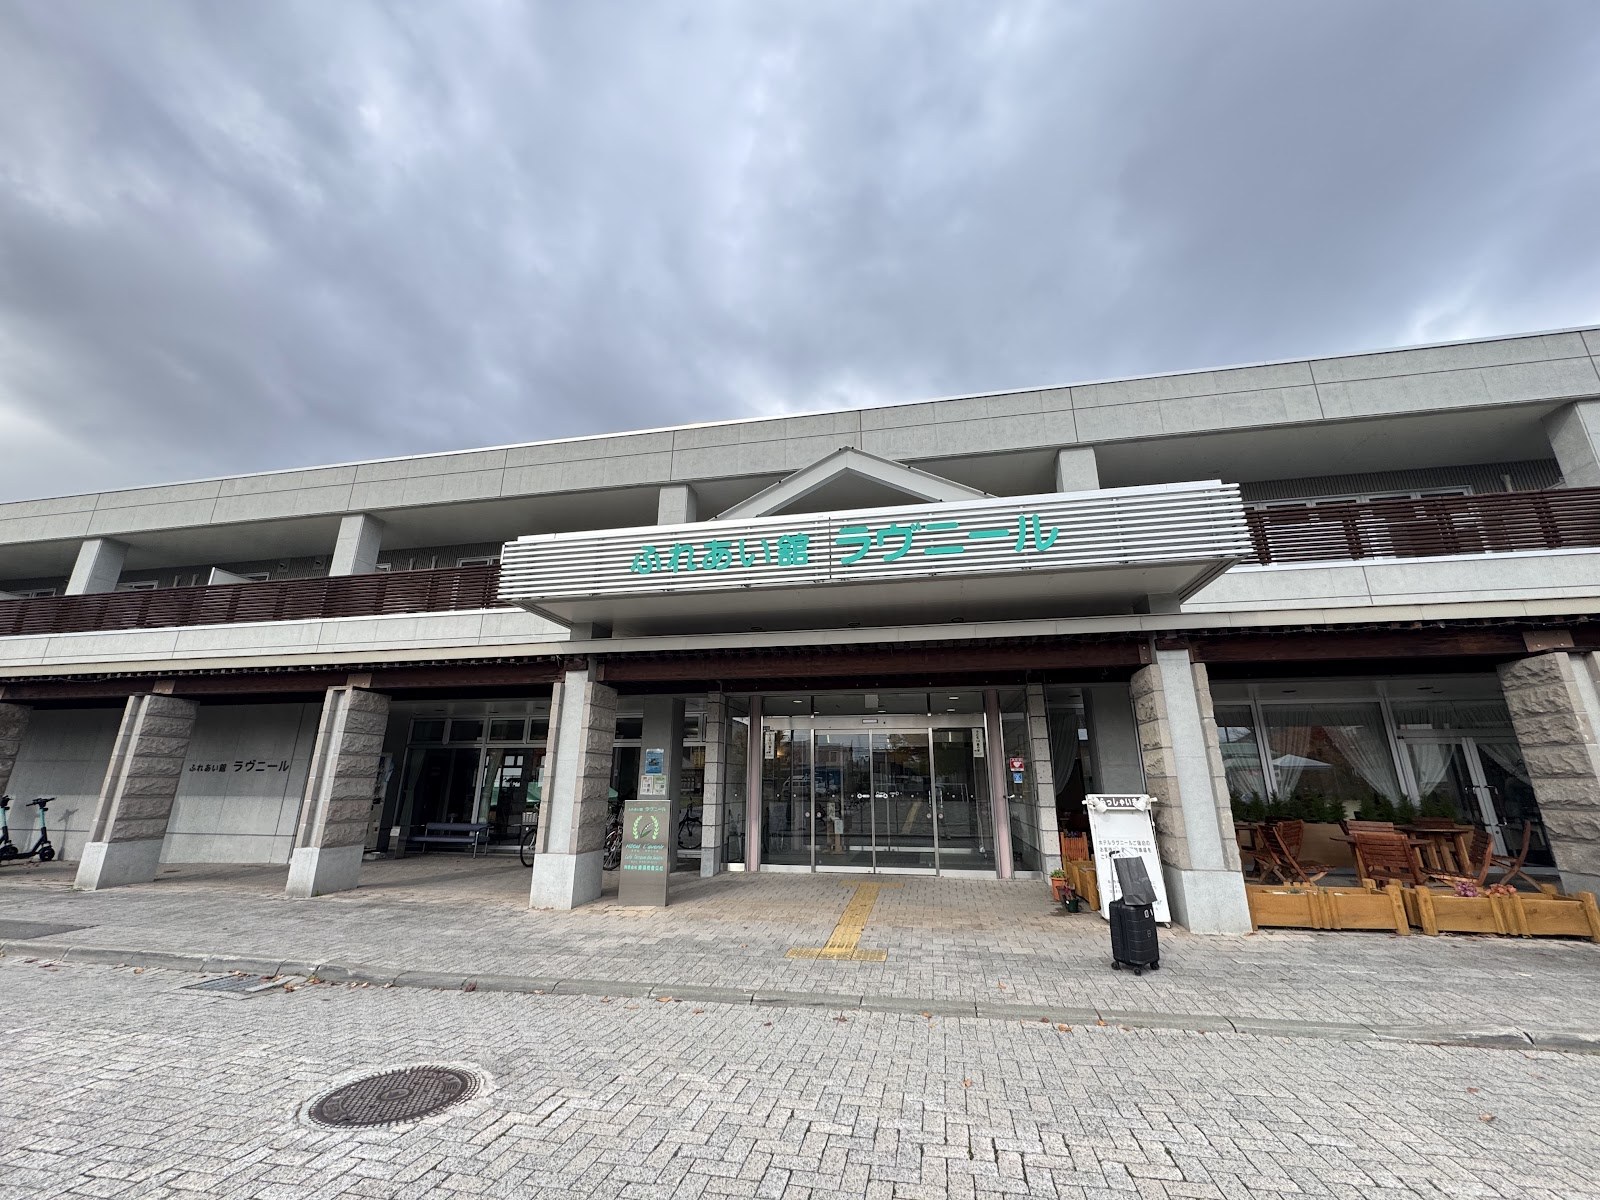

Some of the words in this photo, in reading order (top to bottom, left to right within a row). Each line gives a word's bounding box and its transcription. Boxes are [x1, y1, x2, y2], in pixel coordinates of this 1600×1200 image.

[835, 514, 1058, 564] ラヴニール
[233, 759, 290, 773] ラヴニール
